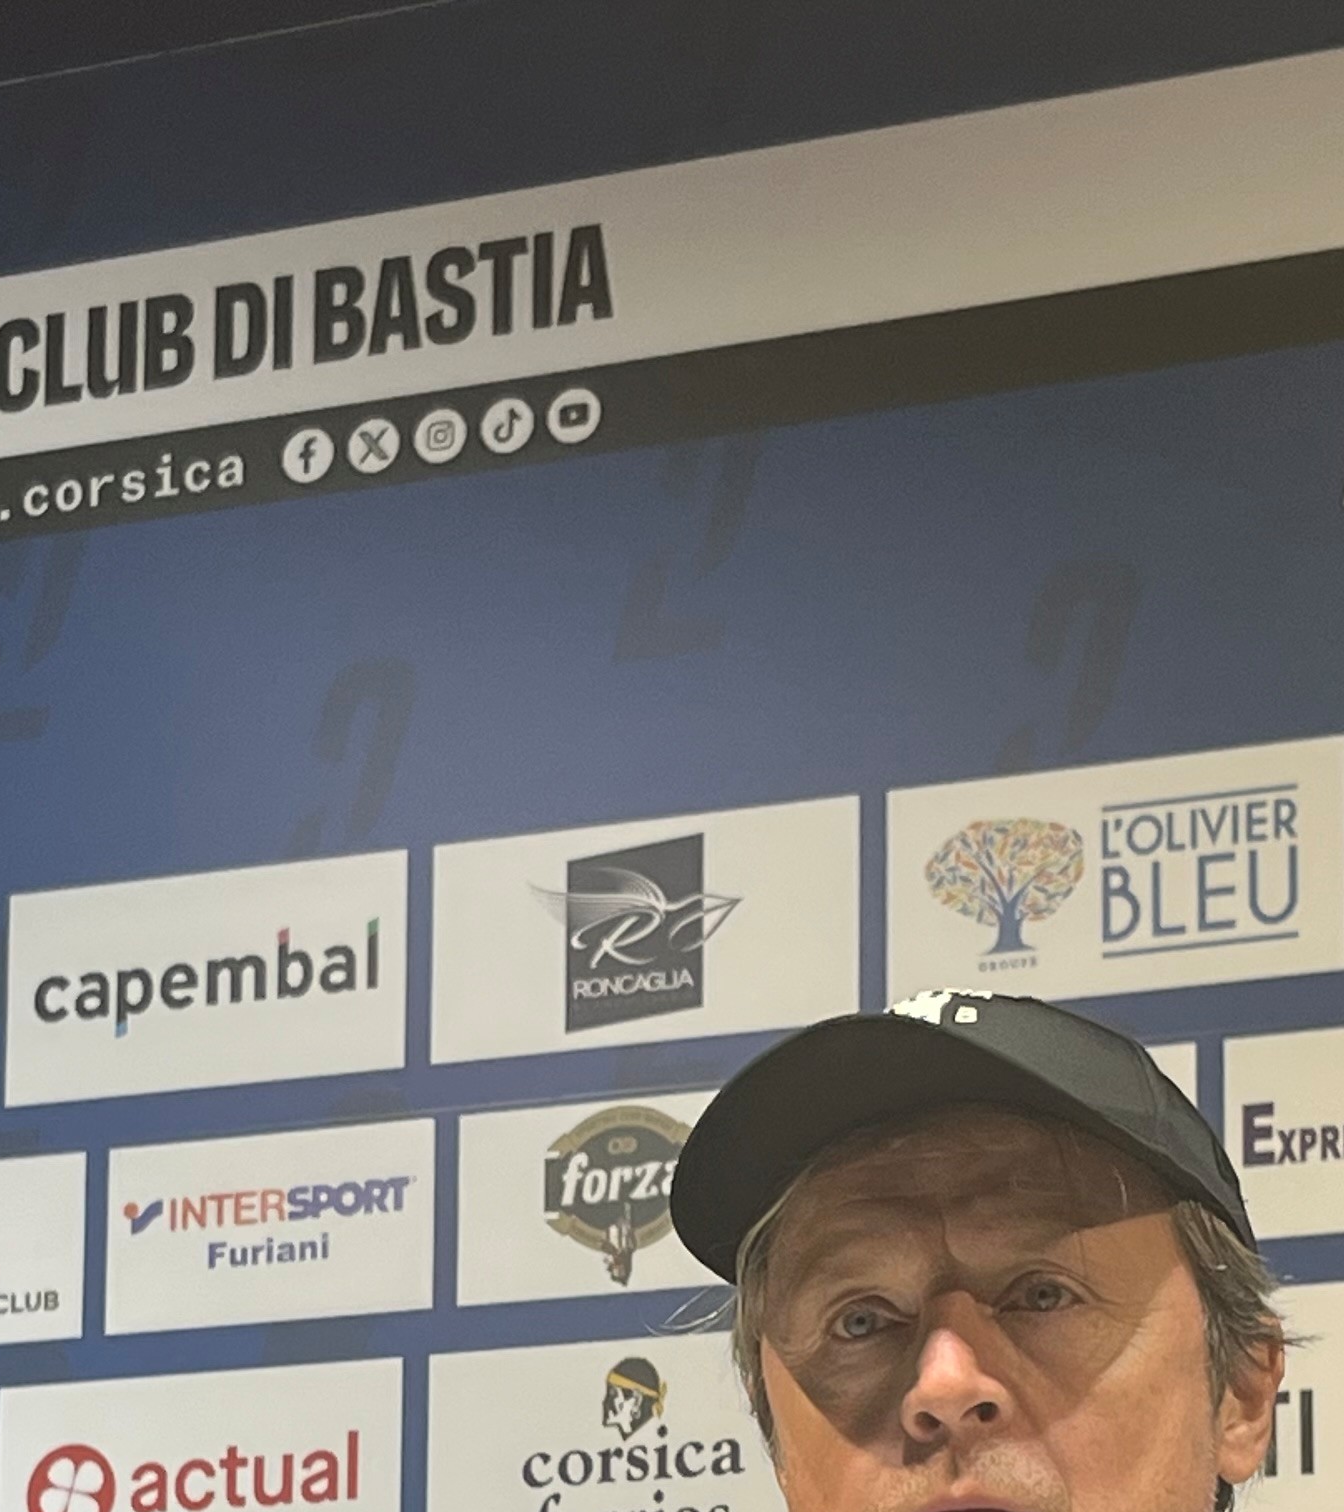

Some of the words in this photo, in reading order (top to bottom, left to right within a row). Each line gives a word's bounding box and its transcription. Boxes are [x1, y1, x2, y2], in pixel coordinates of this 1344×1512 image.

[213, 276, 292, 378] DI
[313, 224, 614, 366] BASTIA
[1101, 799, 1299, 859] L'OLIVIER
[1101, 845, 1299, 942] BLEU
[33, 916, 380, 1038] capembal
[573, 967, 695, 999] RONCAGLIA
[169, 1177, 409, 1232] INTERSPORT
[207, 1232, 330, 1270] Furiani
[522, 1426, 745, 1489] corsica
